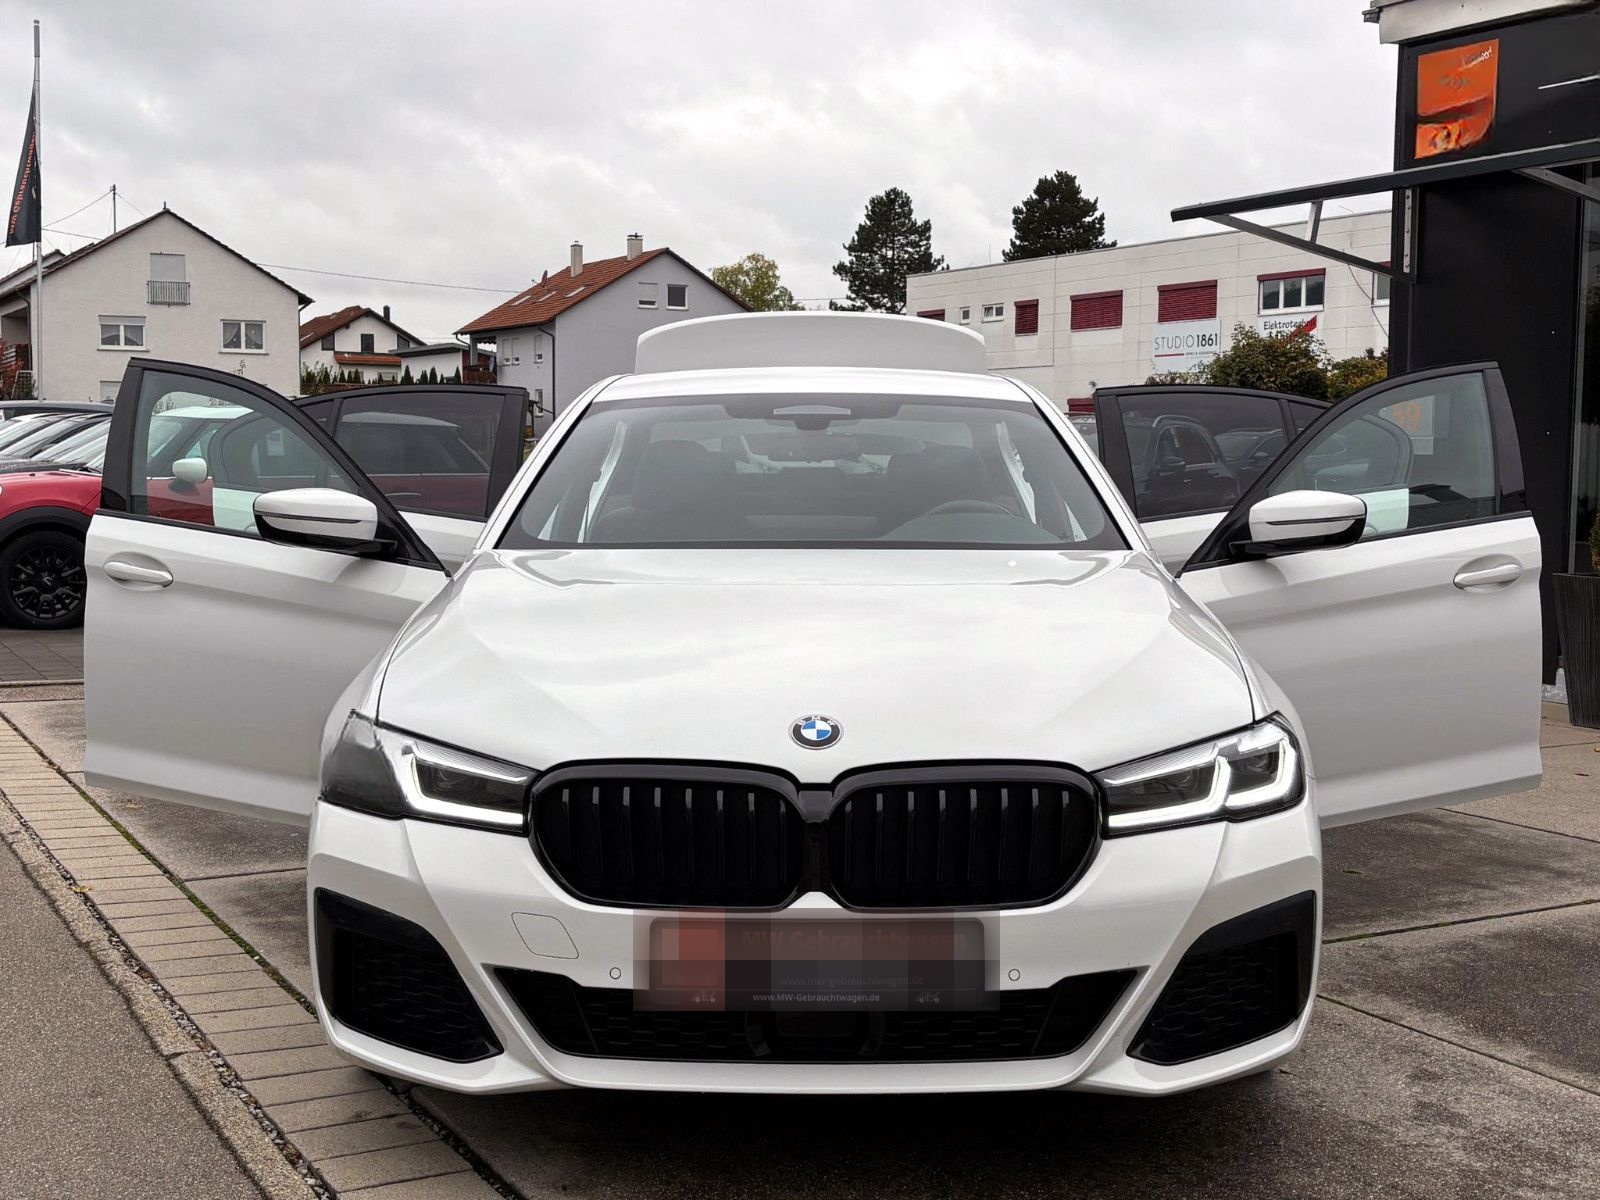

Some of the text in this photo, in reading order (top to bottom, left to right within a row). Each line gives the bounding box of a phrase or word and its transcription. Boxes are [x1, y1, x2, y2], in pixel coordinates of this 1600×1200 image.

[742, 929, 967, 953] MW Gebrauchtwagen
[752, 993, 881, 1004] www.MW-Gebrauchtwagen.de
